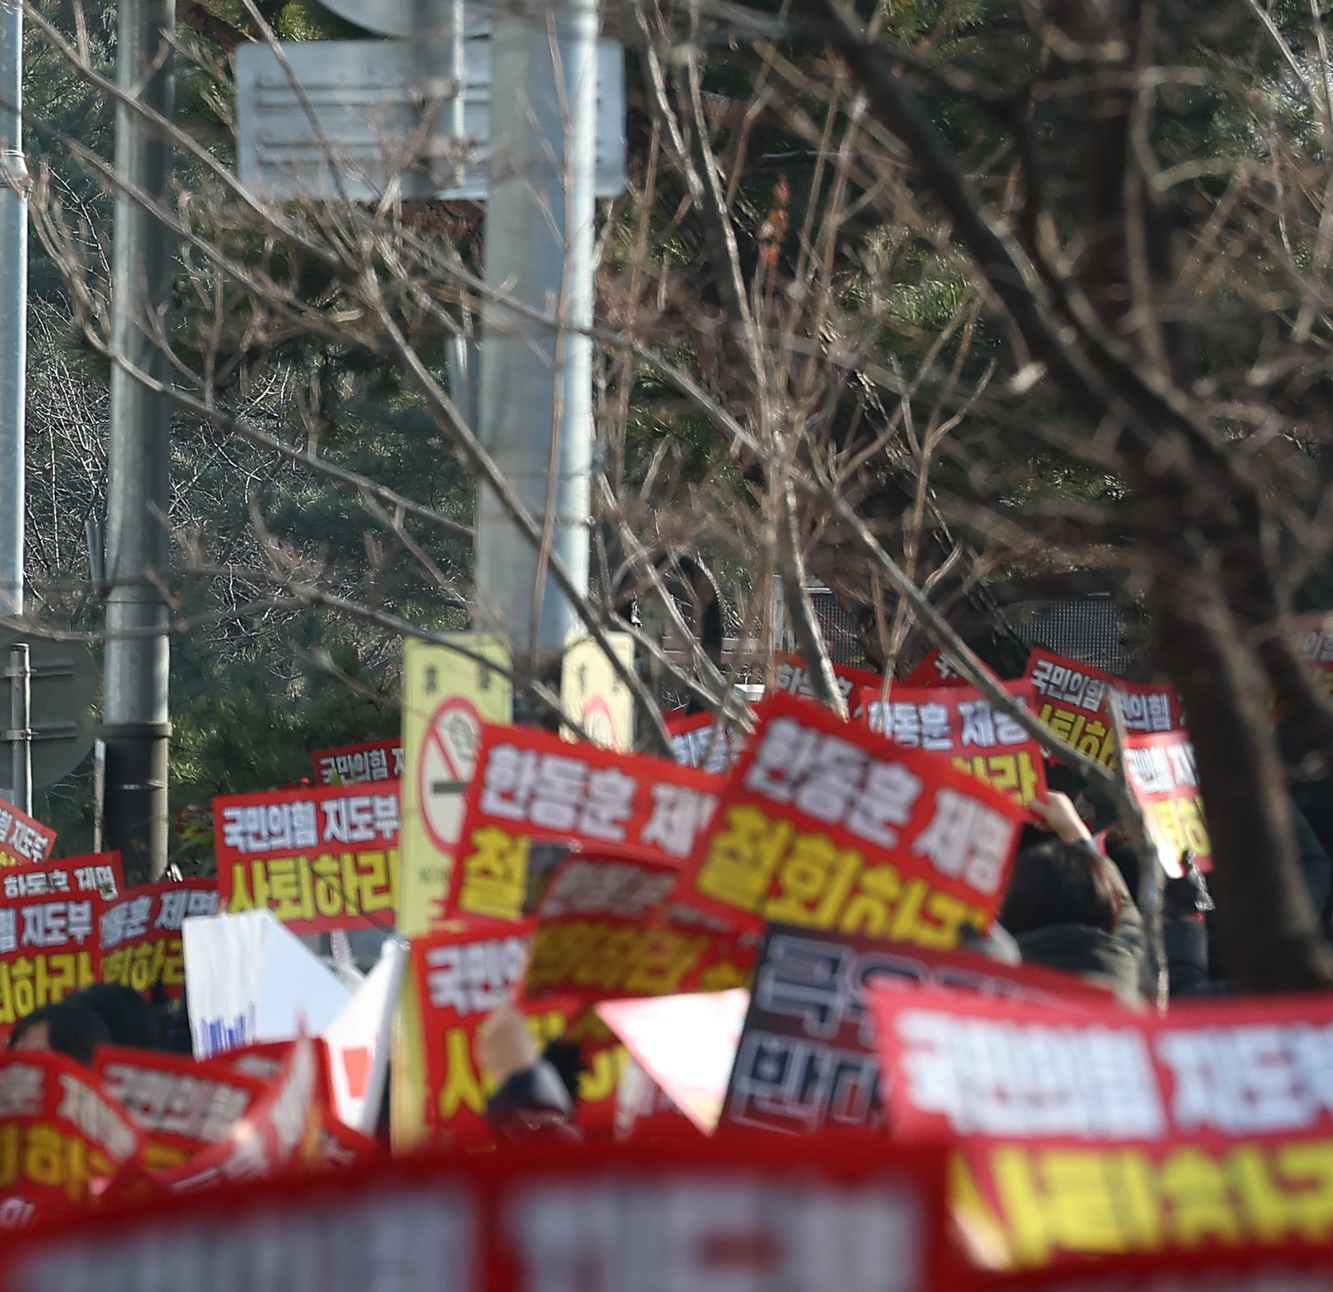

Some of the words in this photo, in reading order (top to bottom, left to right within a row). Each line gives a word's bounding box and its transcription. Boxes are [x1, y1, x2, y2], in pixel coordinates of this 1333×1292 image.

[222, 799, 319, 854] 국민의힘
[320, 793, 402, 843] 지도부
[479, 743, 637, 844] 한동훈
[640, 781, 720, 858] 제
[20, 899, 94, 948] 지도부
